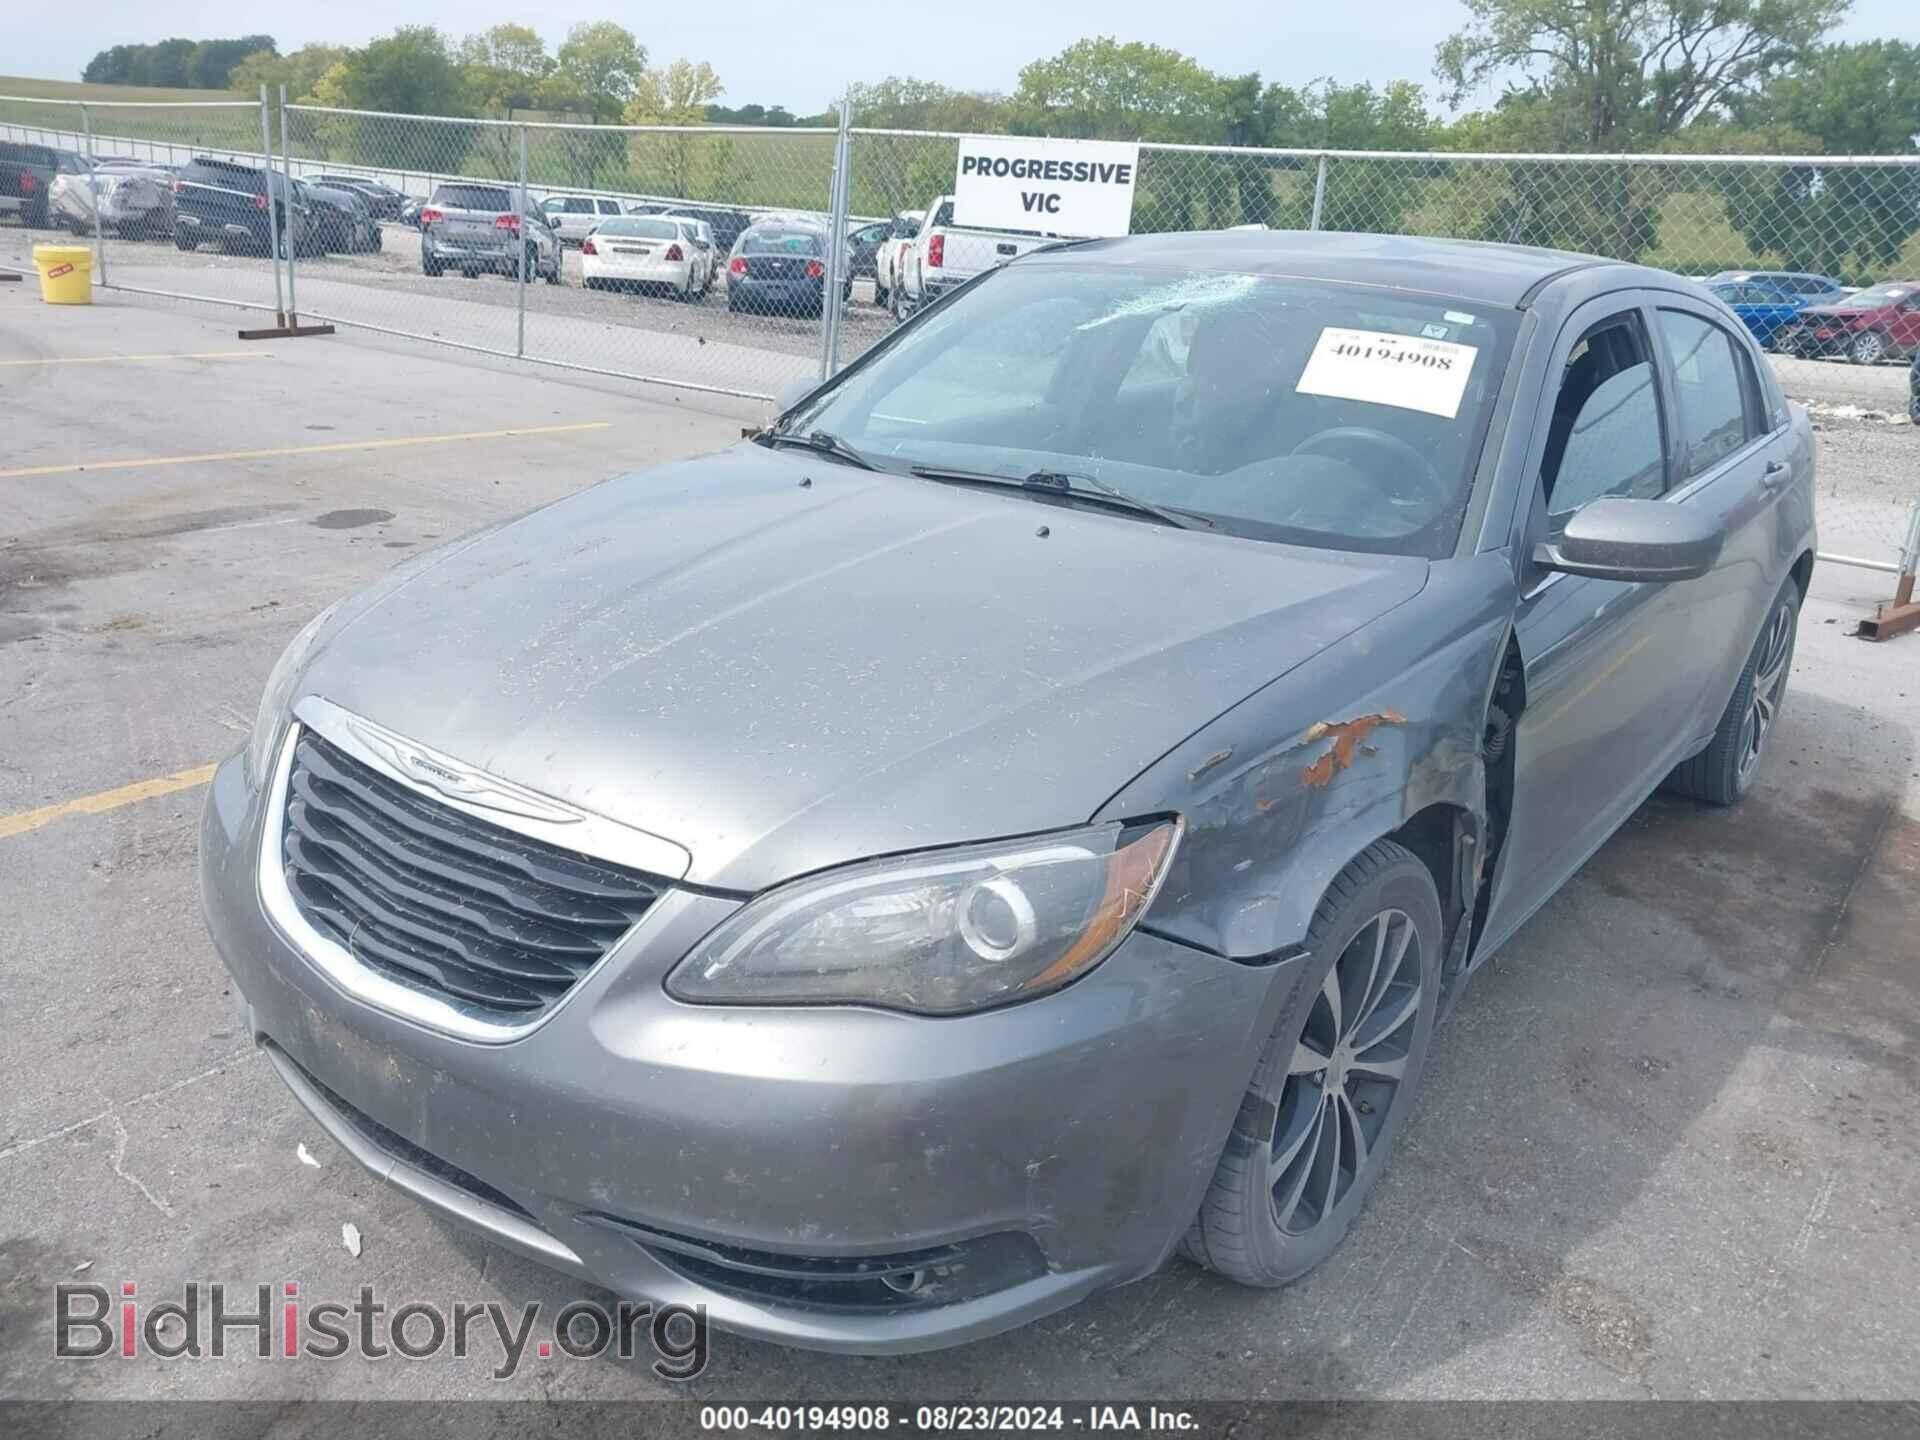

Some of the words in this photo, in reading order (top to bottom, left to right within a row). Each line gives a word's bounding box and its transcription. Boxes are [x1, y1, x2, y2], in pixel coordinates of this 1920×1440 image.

[962, 155, 1132, 184] PROGRESSIVE
[1021, 191, 1061, 213] VIC
[1331, 342, 1454, 370] 40194908
